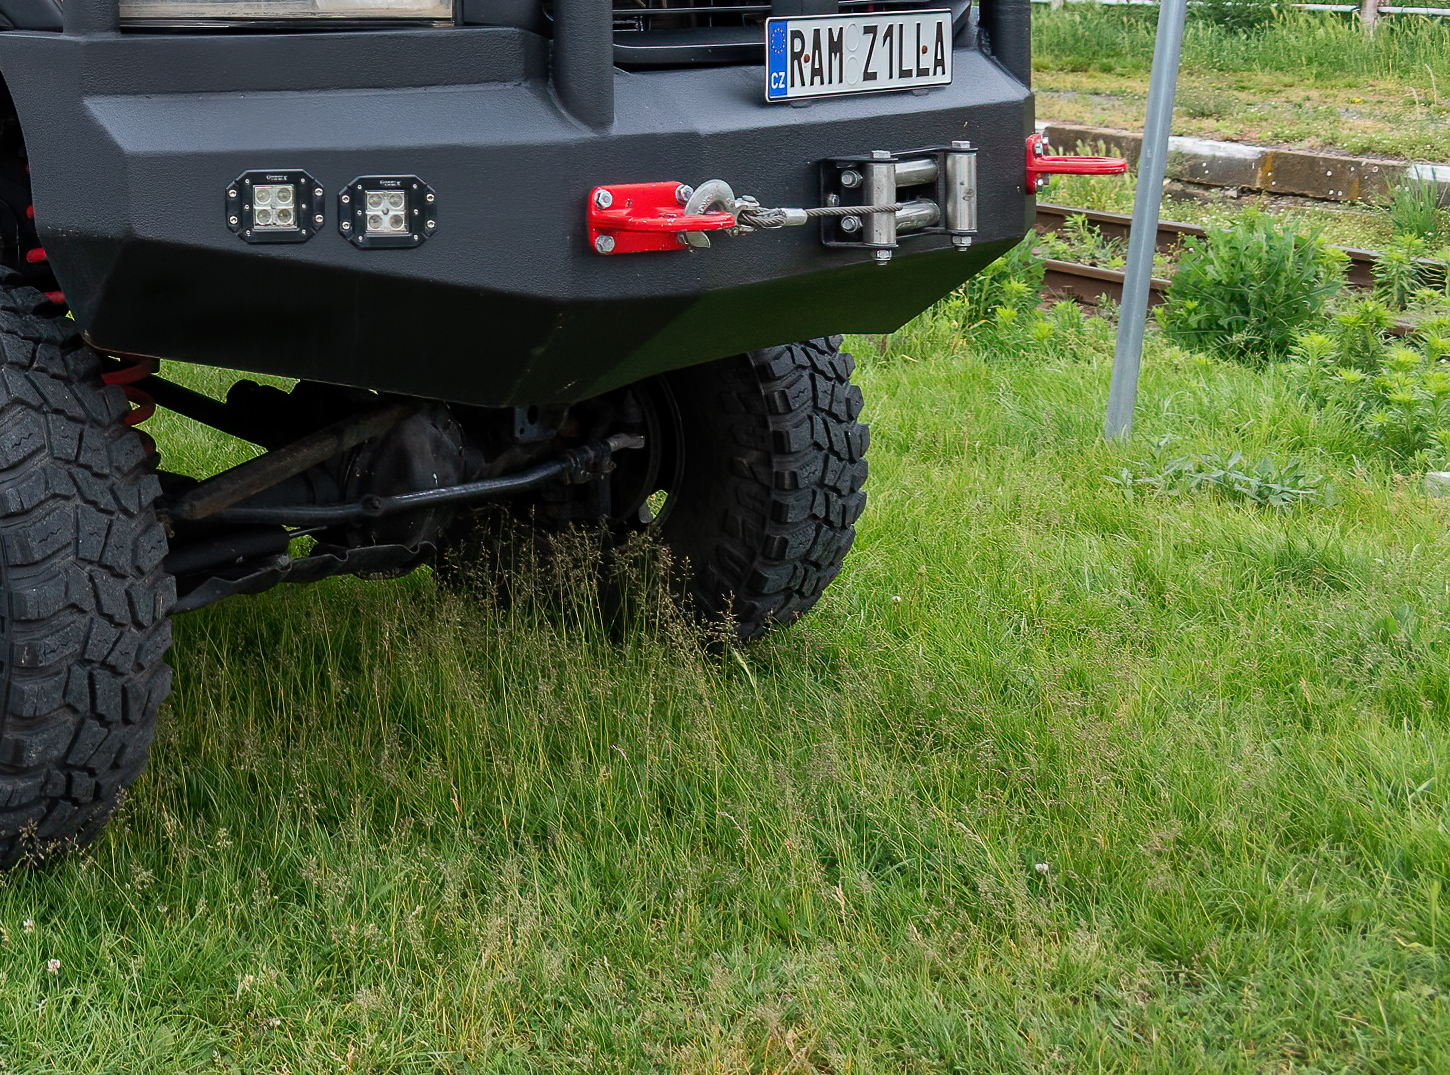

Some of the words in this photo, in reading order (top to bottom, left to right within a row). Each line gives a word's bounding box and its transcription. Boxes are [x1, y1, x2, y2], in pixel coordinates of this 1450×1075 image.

[789, 27, 844, 88] RAM
[862, 21, 946, 82] Z1LLA
[770, 71, 786, 89] CZ
